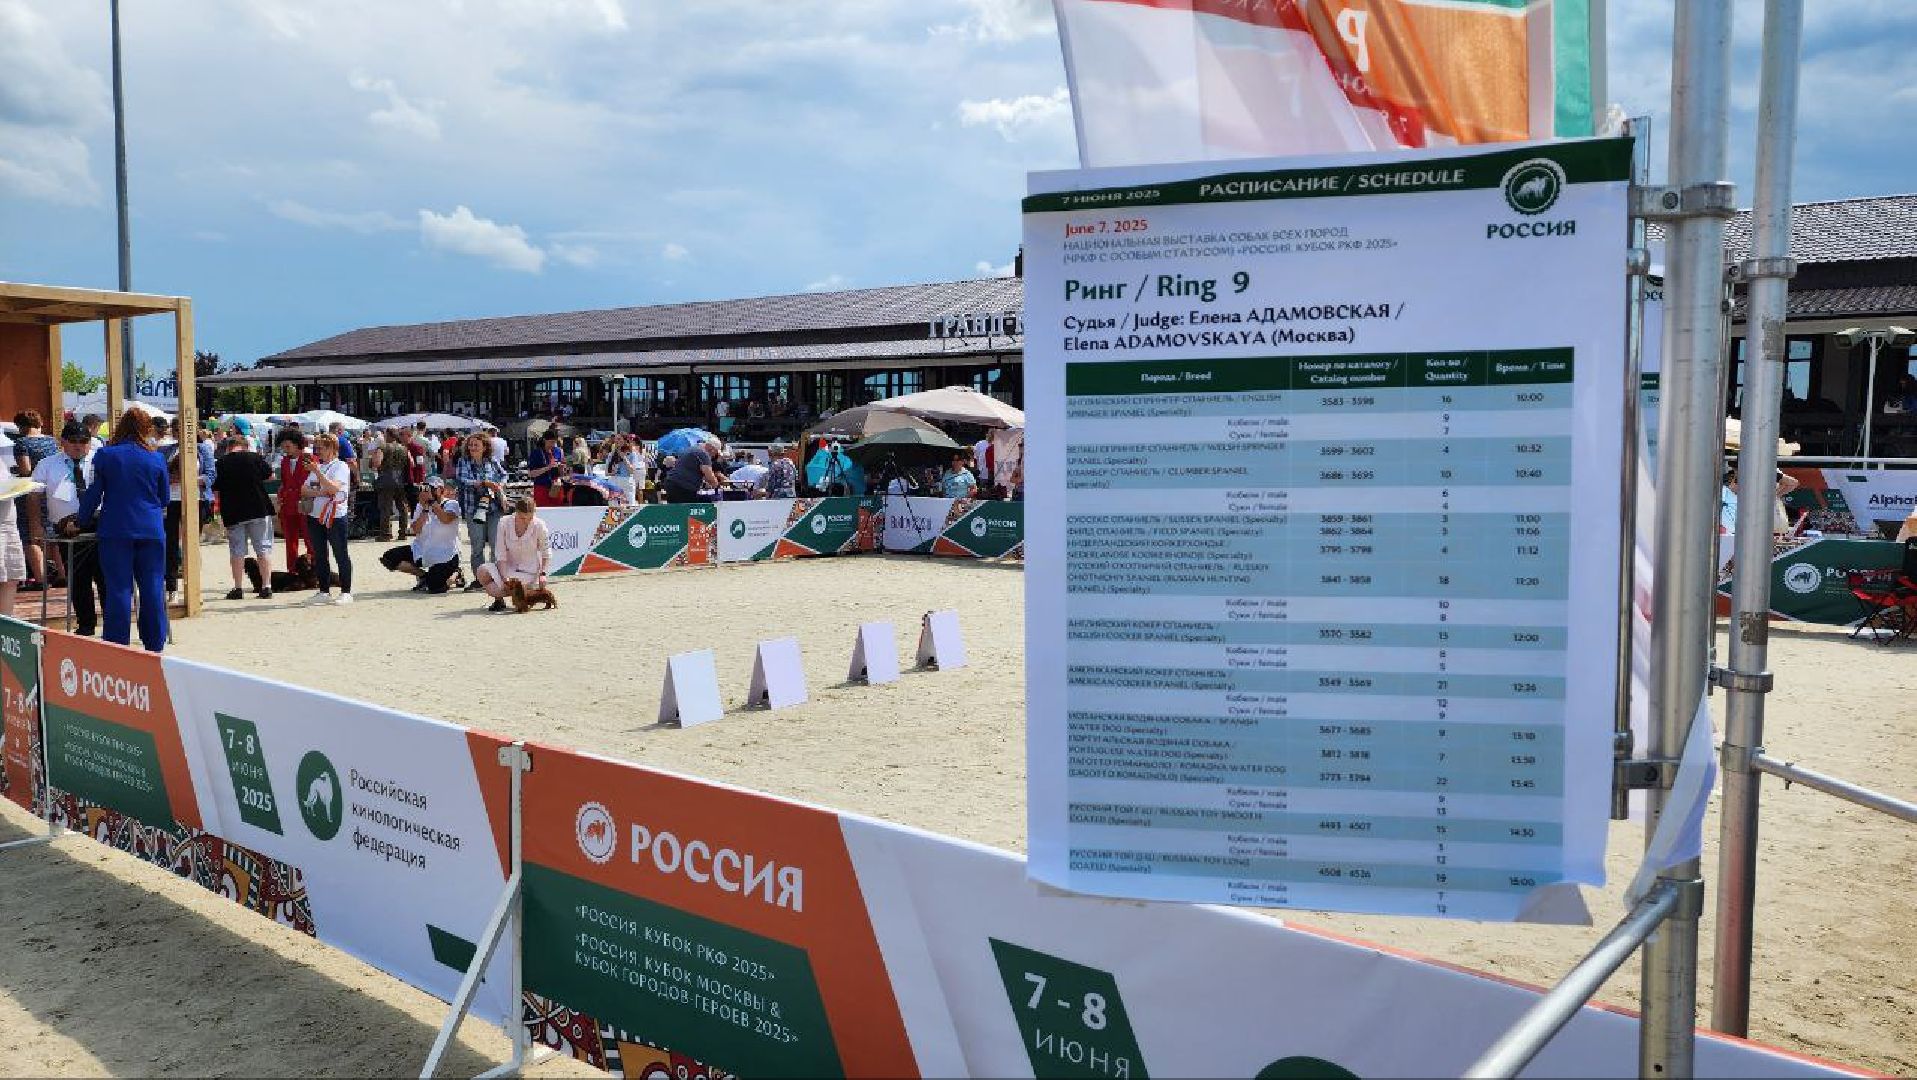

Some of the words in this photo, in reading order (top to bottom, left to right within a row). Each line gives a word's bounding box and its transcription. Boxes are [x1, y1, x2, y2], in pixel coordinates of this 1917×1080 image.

[1200, 175, 1339, 197] РАСПИСАНИЕ
[1358, 168, 1466, 190] SCHEDULE
[1061, 196, 1069, 204] 7
[1126, 190, 1161, 200] 2025
[1063, 237, 1160, 251] НАЦИОНАЛЬНАЯ
[1163, 233, 1226, 245] ВЫСТАВКА
[1229, 231, 1268, 242] СОБАК
[1272, 229, 1301, 240] ВСЕХ
[1304, 226, 1348, 239] ПОРОД
[1065, 223, 1095, 238] June
[1114, 219, 1148, 233] 2025
[1487, 220, 1576, 239] РОССИЯ
[1110, 249, 1162, 262] ОСОБЫМ
[1295, 240, 1334, 252] КУБОК
[1337, 239, 1363, 250] РКФ
[1065, 279, 1127, 301] Ринг
[1135, 274, 1149, 302] /
[1157, 274, 1217, 302] Ring
[1232, 271, 1249, 294] 9
[1063, 315, 1116, 333] Судья
[1133, 310, 1185, 331] Judge:
[1189, 310, 1241, 325] Елена
[1246, 303, 1390, 324] АДАМОВСКАЯ
[1064, 337, 1109, 351] Elena
[1113, 330, 1267, 350] ADAMOVSKAYA
[1272, 327, 1356, 346] (Москва)
[1184, 370, 1212, 380] Breed
[1299, 361, 1331, 372] Номер
[1310, 373, 1347, 384] Catalog
[1349, 373, 1386, 382] number
[1425, 370, 1468, 382] Quantity
[1541, 361, 1565, 370] Time
[1260, 430, 1289, 439] female
[1268, 418, 1289, 426] male
[1869, 494, 1917, 507] Alpha
[82, 668, 150, 712] РОССИЯ
[226, 728, 235, 749] 7
[246, 734, 255, 755] 8
[241, 785, 272, 812] 2025
[350, 768, 427, 810] Российская
[352, 802, 460, 852] кинологическая
[352, 826, 426, 869] федерация
[631, 822, 803, 913] РОССИЯ
[644, 926, 692, 956] КУБОК
[697, 944, 728, 966] РКФ
[732, 956, 775, 980] 2025»
[575, 950, 618, 979] КУБОК
[622, 966, 750, 1027] ГОРОДОВ-ГЕРОЕВ
[754, 1016, 799, 1043] 2025»
[644, 955, 692, 986] КУБОК
[697, 974, 764, 1012] МОСКВЫ
[770, 1001, 781, 1018] &
[1025, 972, 1047, 1009] 7
[1082, 992, 1107, 1030] 8
[1037, 1028, 1130, 1079] ИЮНЯ
